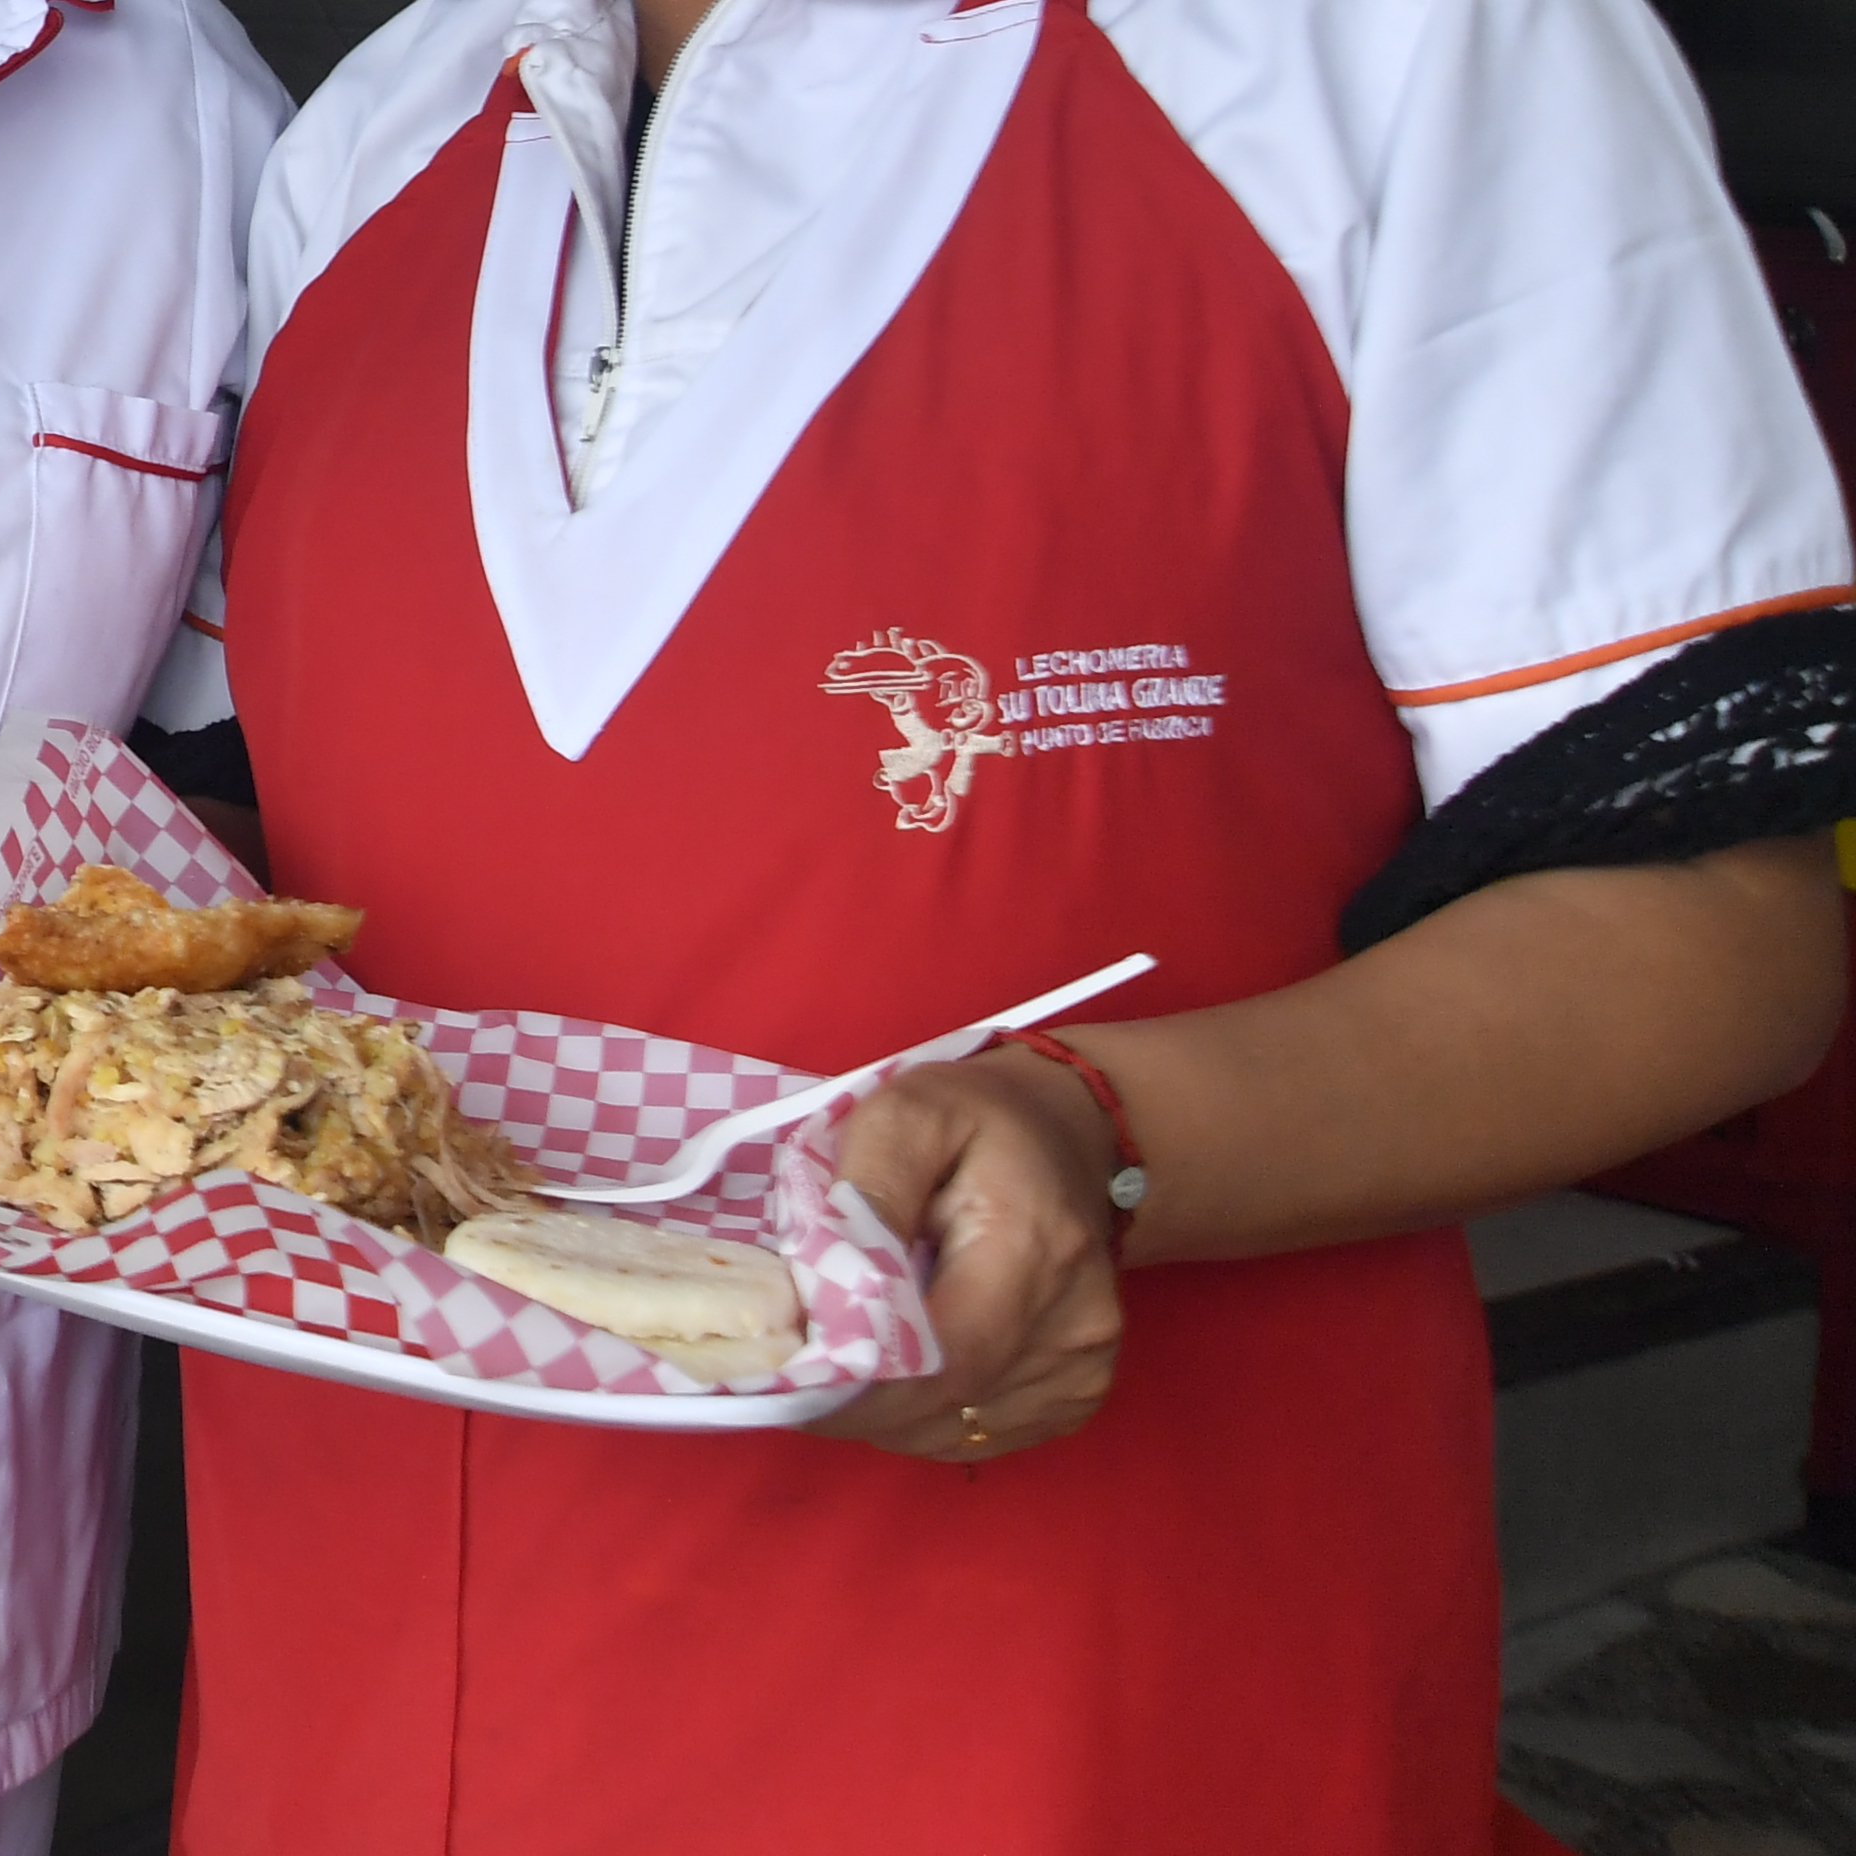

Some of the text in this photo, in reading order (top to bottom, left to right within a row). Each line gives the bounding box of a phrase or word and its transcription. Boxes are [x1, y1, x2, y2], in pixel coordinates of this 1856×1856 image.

[1015, 644, 1188, 682] LECHONERIA
[997, 674, 1229, 725] SU TOLIMA GRANDE
